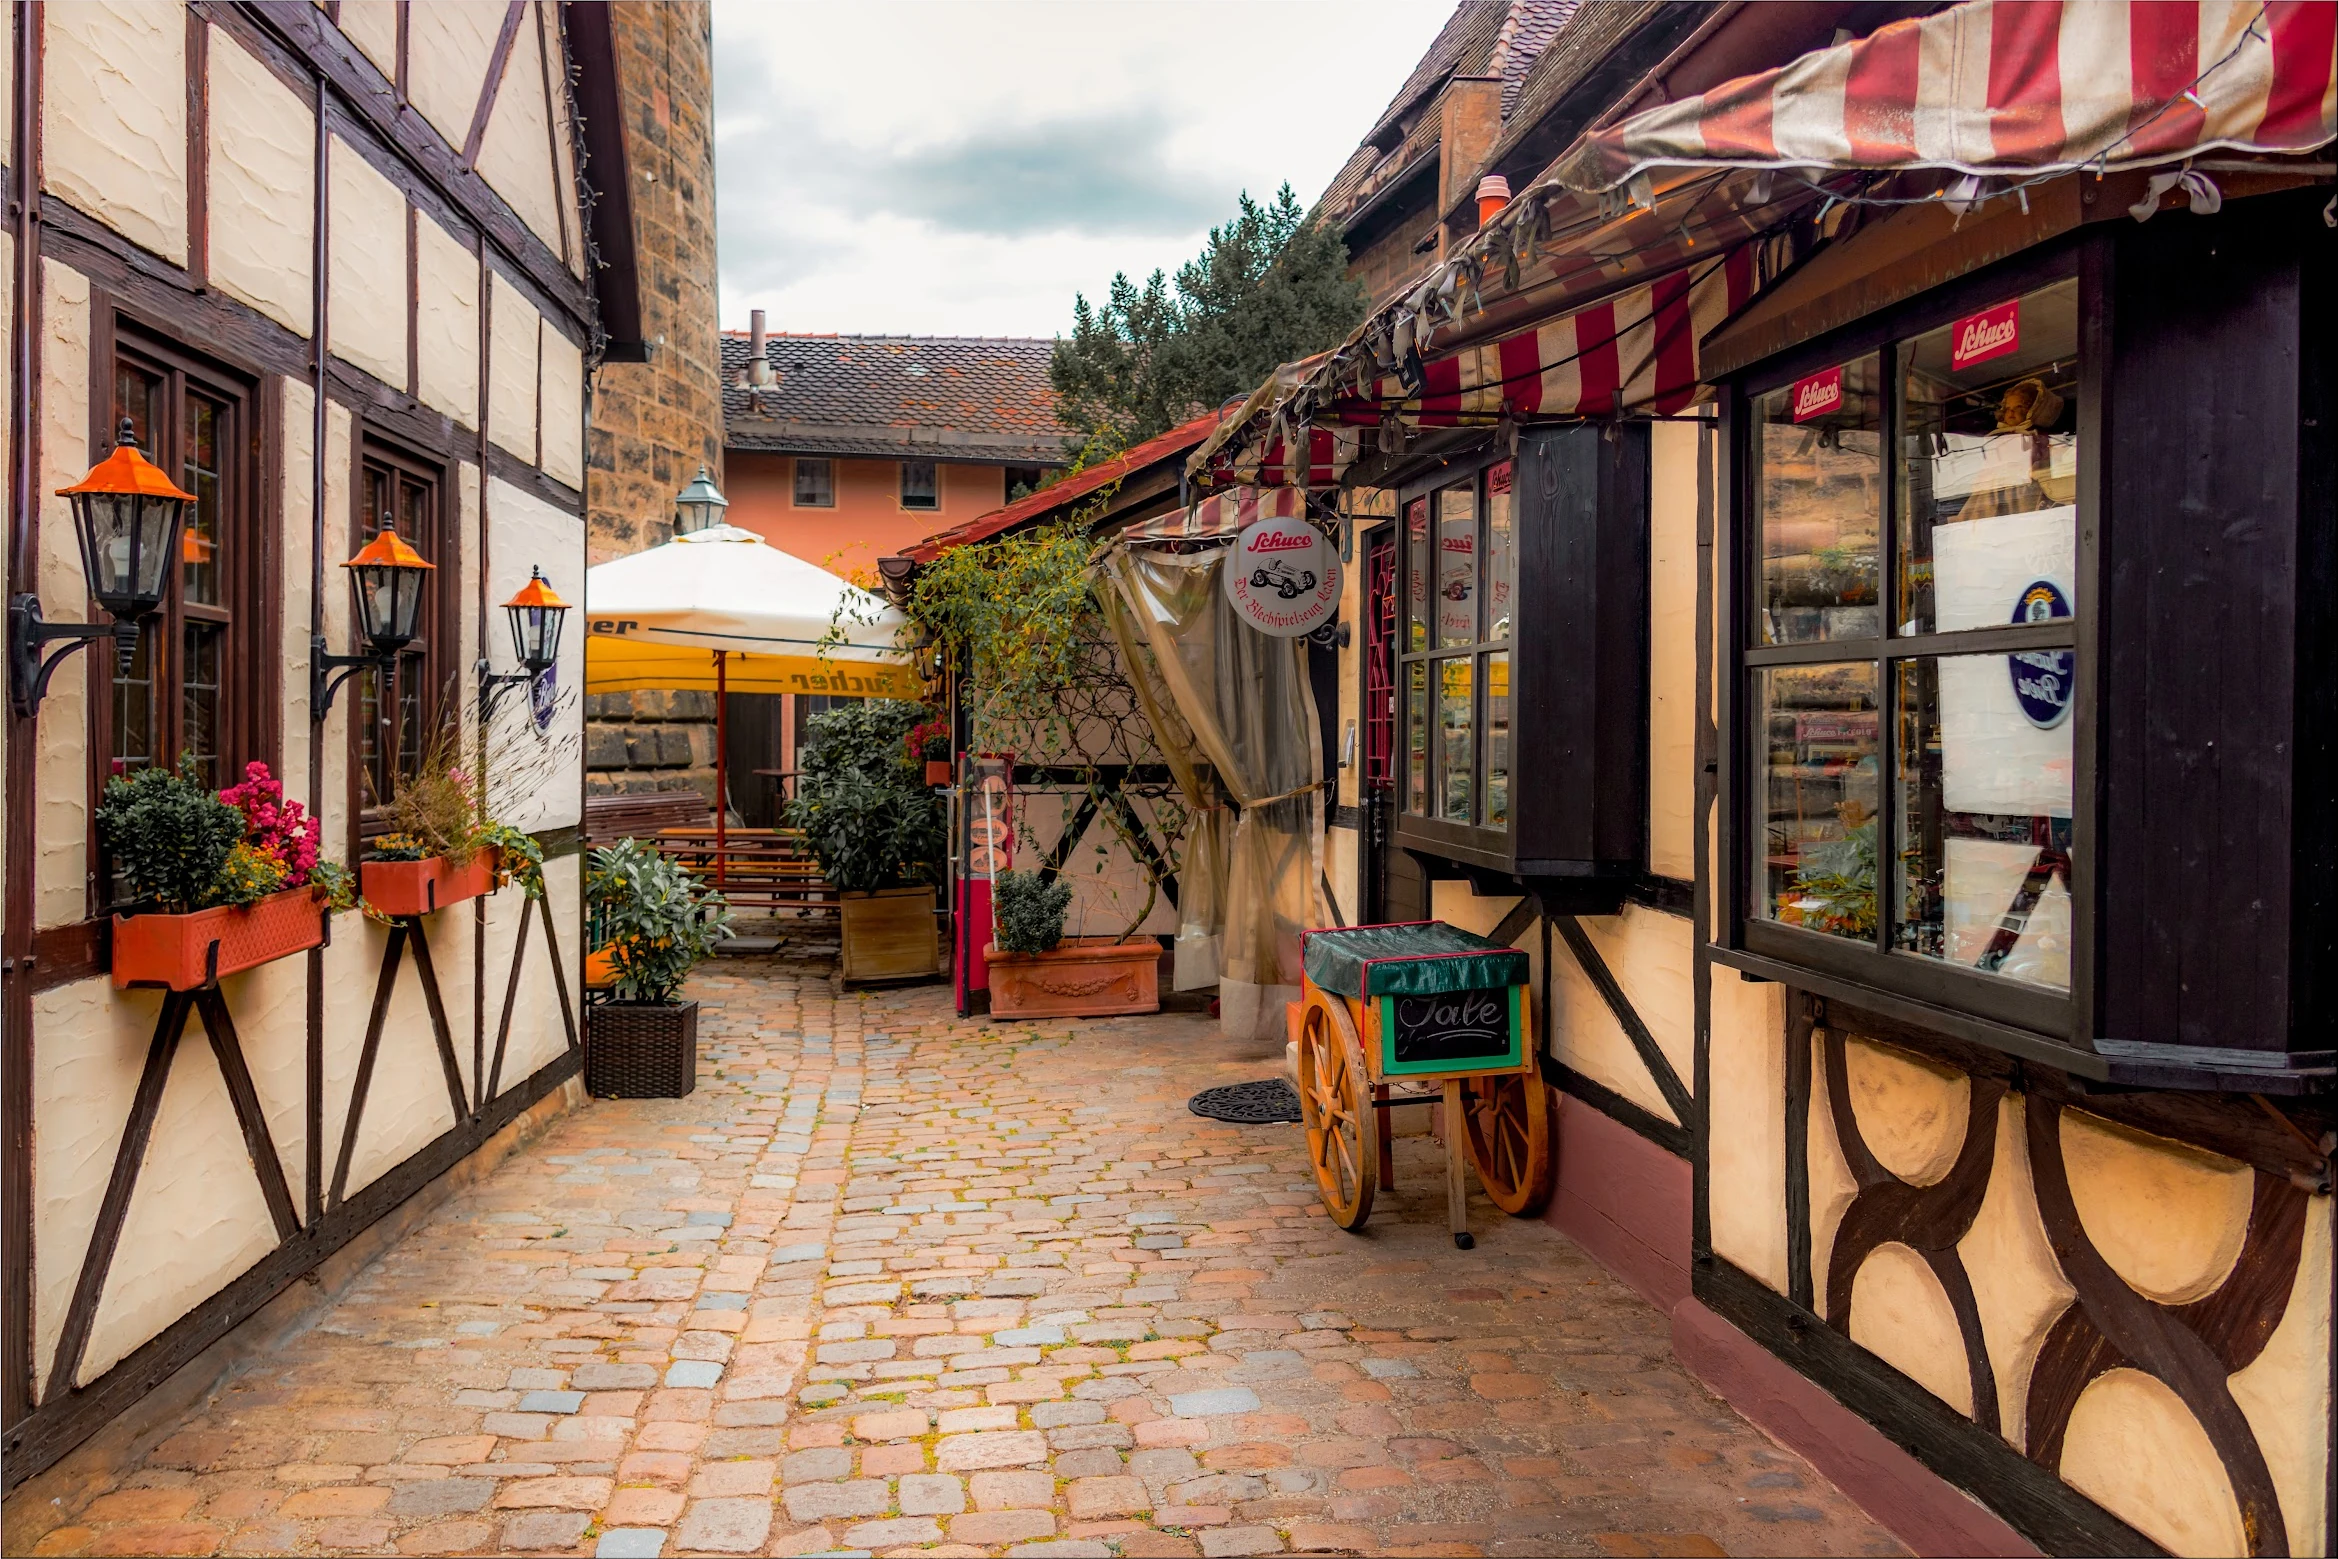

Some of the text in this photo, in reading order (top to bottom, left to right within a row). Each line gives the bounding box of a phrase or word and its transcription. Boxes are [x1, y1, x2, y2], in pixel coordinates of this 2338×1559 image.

[1955, 319, 2015, 361] Schuco
[1795, 381, 1839, 416] Schuco
[1247, 531, 1313, 553] Schuco
[1234, 577, 1248, 601] Der
[586, 621, 638, 634] er
